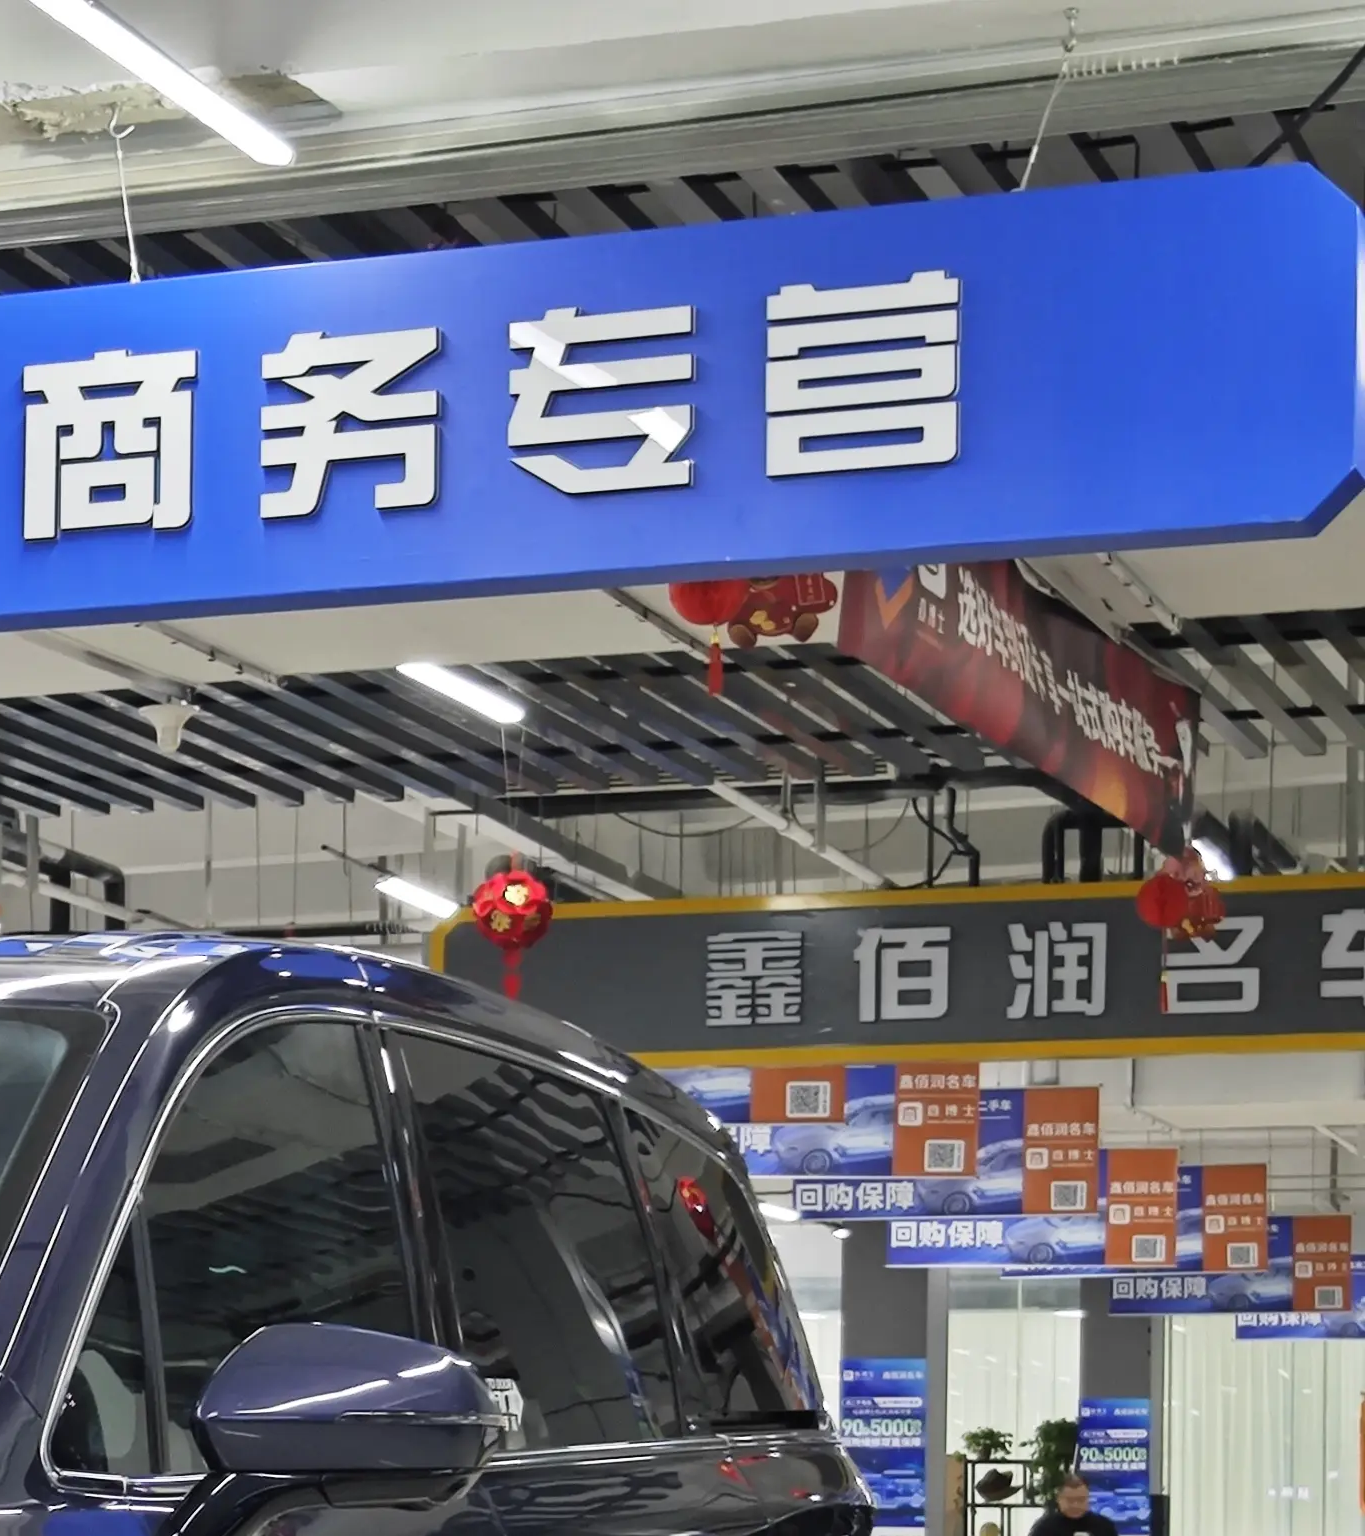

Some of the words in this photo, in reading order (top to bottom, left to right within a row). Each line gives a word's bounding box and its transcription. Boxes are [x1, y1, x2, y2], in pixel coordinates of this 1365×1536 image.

[21, 268, 961, 541] 商务专营
[795, 1181, 915, 1211] 回购保障
[890, 1220, 1003, 1249] 回购保障
[1112, 1276, 1207, 1300] 回购保障
